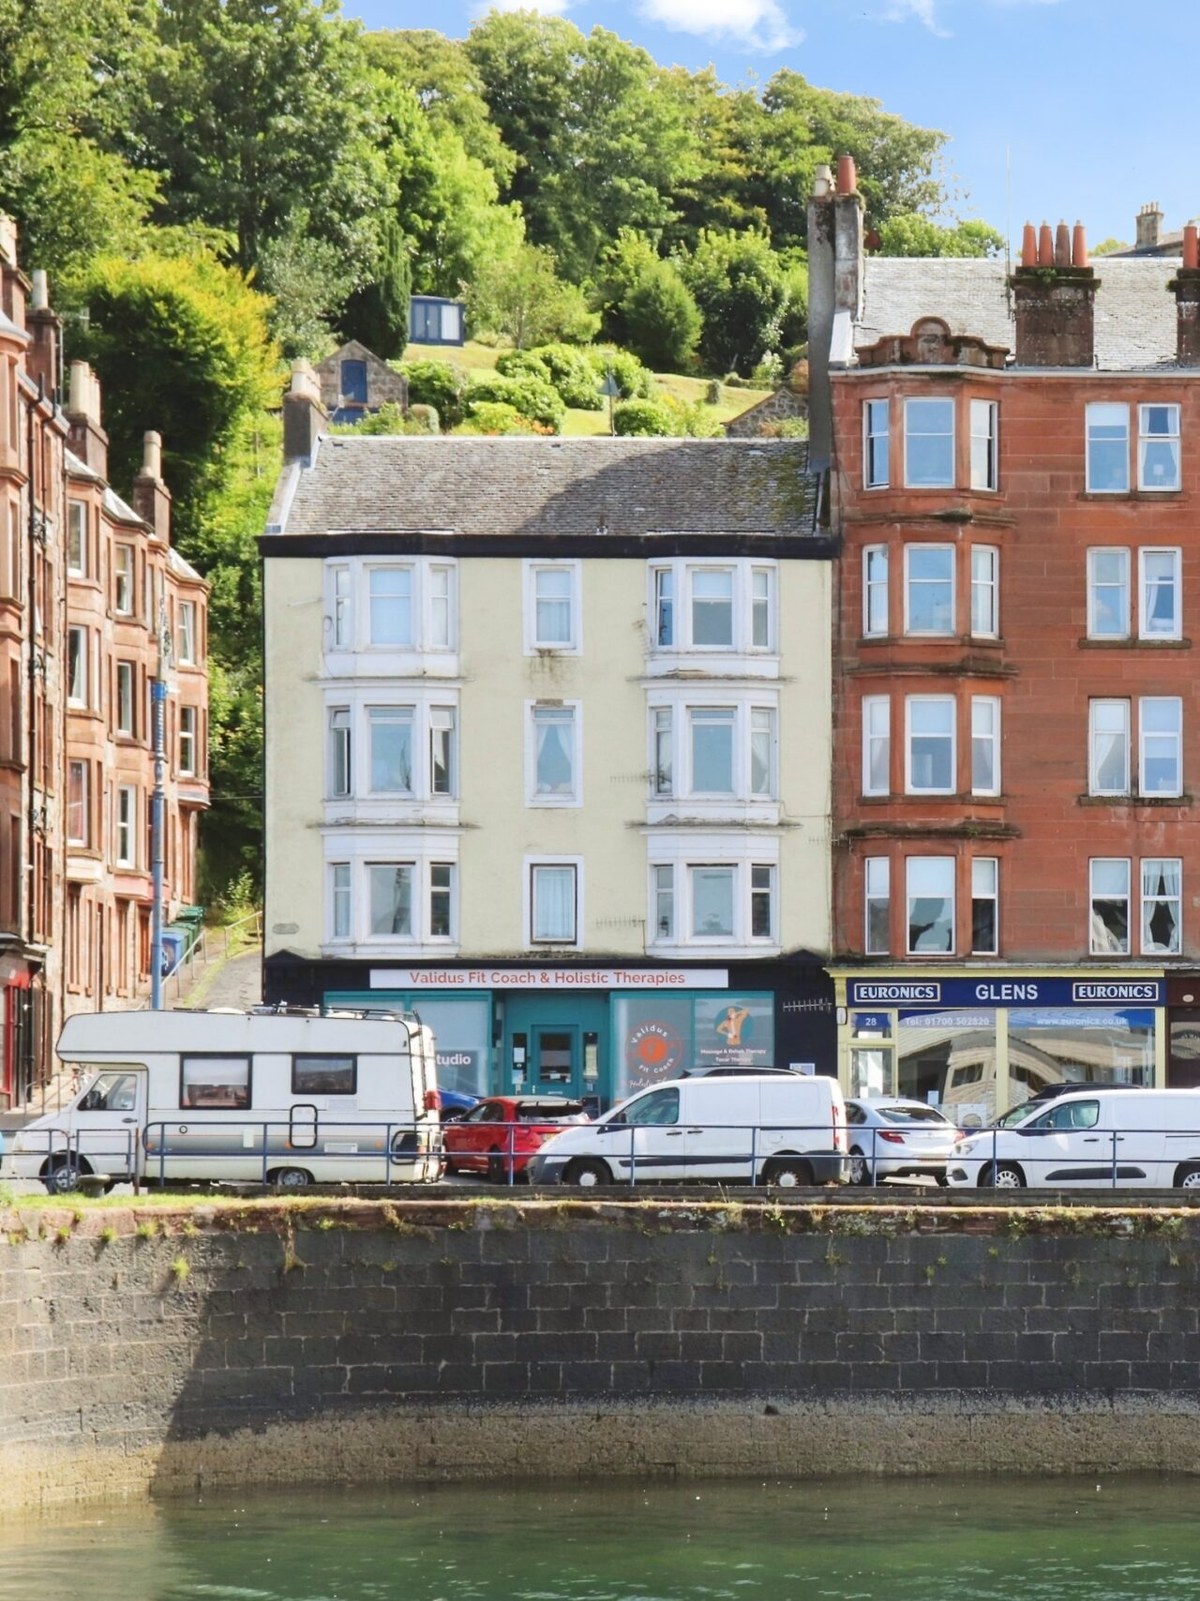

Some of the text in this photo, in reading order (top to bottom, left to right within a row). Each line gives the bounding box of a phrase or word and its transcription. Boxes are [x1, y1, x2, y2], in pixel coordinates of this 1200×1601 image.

[410, 971, 686, 986] Validus Fit Coach & Holistic Therapies
[859, 986, 935, 999] EURONICS
[975, 984, 1039, 1000] GLENS
[1078, 985, 1153, 998] EURONICS
[865, 1017, 877, 1026] 28
[925, 1017, 953, 1026] 01700
[631, 1024, 668, 1043] Validus
[437, 1053, 472, 1065] tudio
